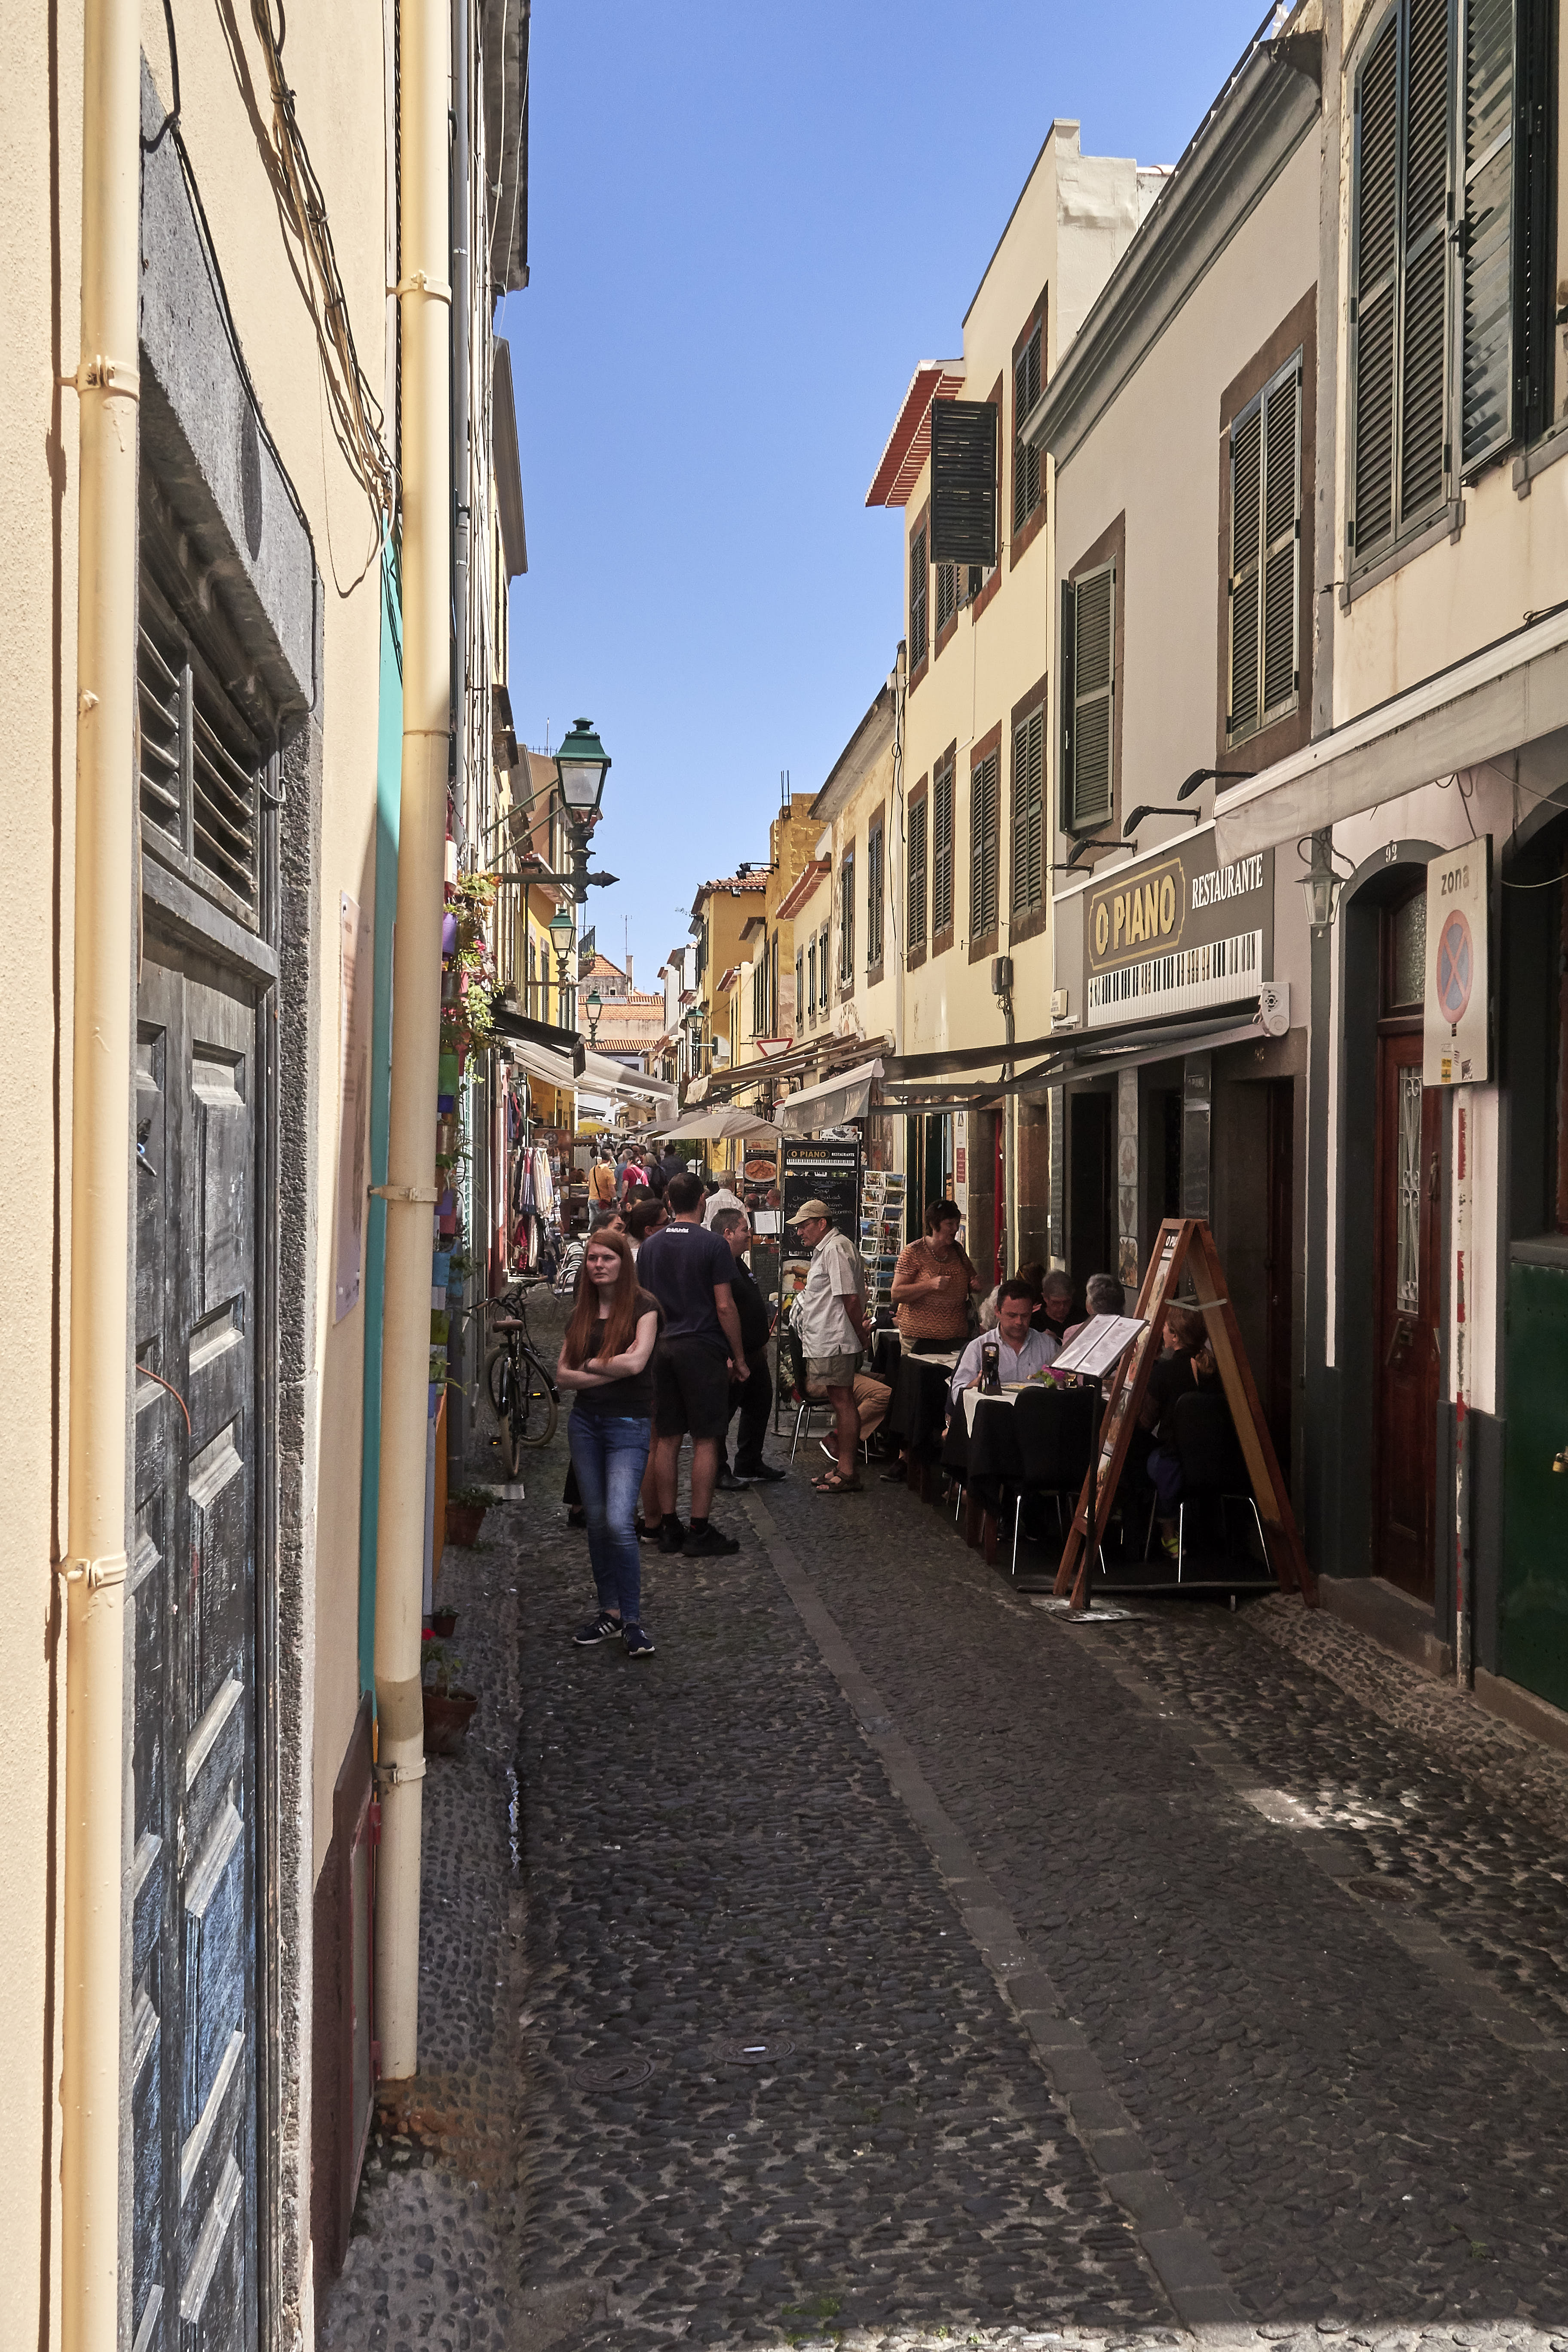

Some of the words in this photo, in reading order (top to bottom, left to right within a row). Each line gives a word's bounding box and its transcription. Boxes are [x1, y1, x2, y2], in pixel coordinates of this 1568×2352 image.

[1386, 844, 1397, 863] 92
[1191, 853, 1263, 910] RESTAURANTE
[1441, 865, 1469, 896] zona
[1096, 902, 1109, 956] O
[1114, 875, 1175, 950] PIANO
